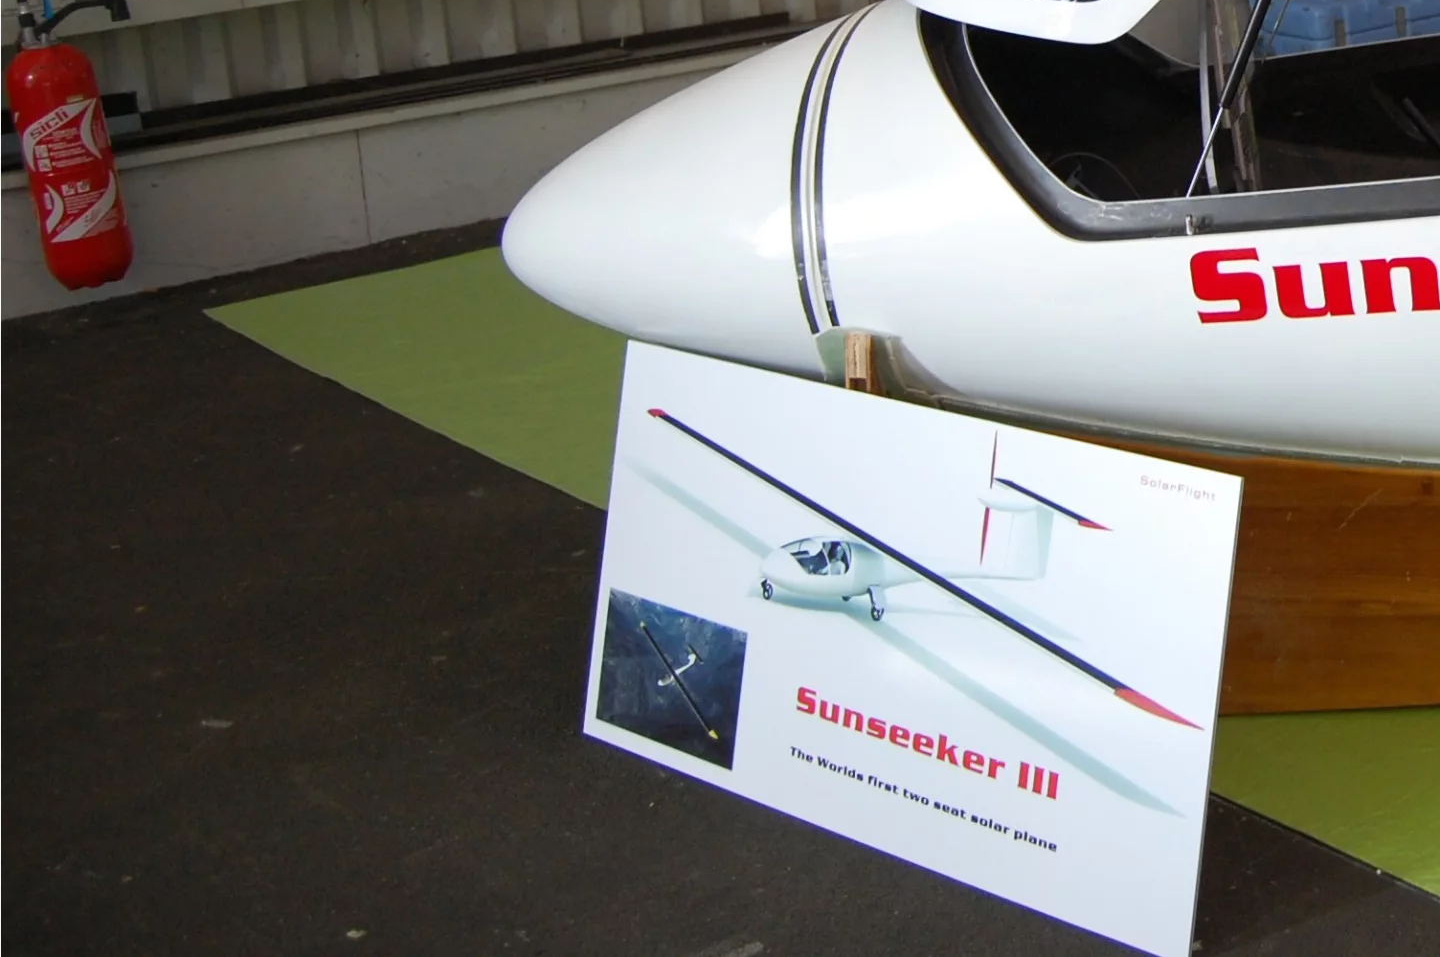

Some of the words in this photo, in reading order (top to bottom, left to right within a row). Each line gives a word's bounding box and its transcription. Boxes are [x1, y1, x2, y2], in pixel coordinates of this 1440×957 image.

[1140, 474, 1217, 501] SolarFlight
[797, 686, 1008, 780] Sunseeker
[1017, 761, 1060, 801] III
[790, 745, 814, 763] The
[816, 756, 865, 783] Worlds
[867, 774, 899, 795] first
[902, 788, 930, 806] two
[933, 800, 967, 820] seat
[970, 814, 1011, 835] solar
[1013, 830, 1058, 853] plane
